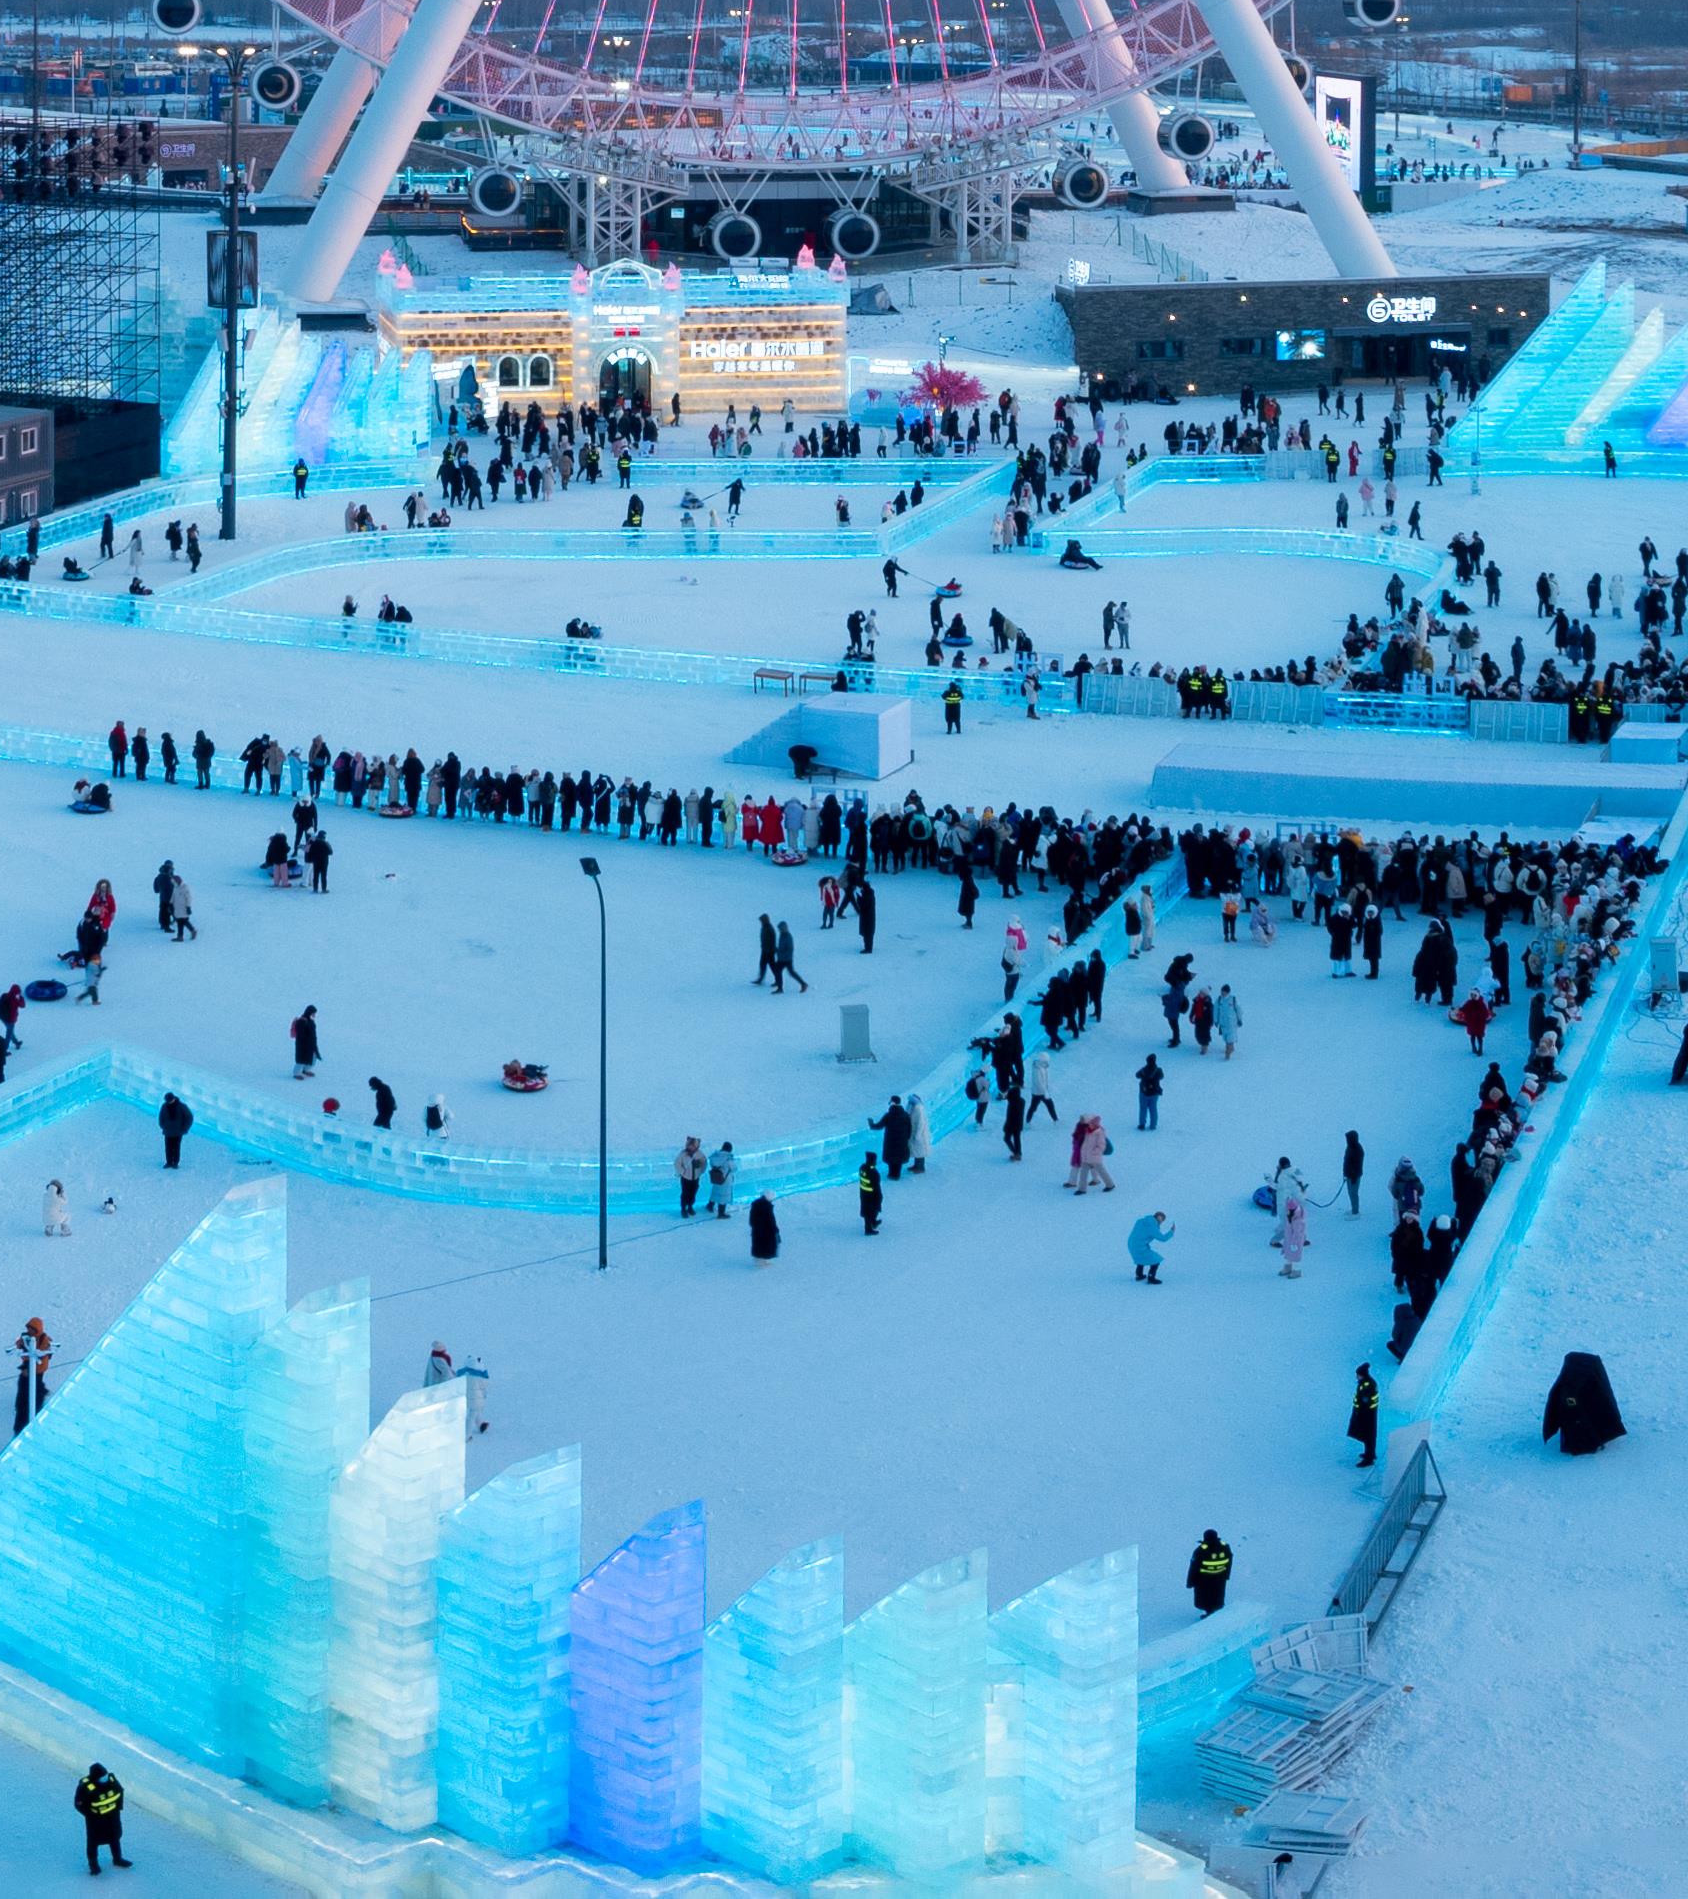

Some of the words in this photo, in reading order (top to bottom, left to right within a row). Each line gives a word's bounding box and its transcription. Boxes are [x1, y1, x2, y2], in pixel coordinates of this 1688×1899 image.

[1391, 297, 1436, 314] 卫生间
[1392, 314, 1433, 322] TOILET
[691, 339, 749, 359] Haier
